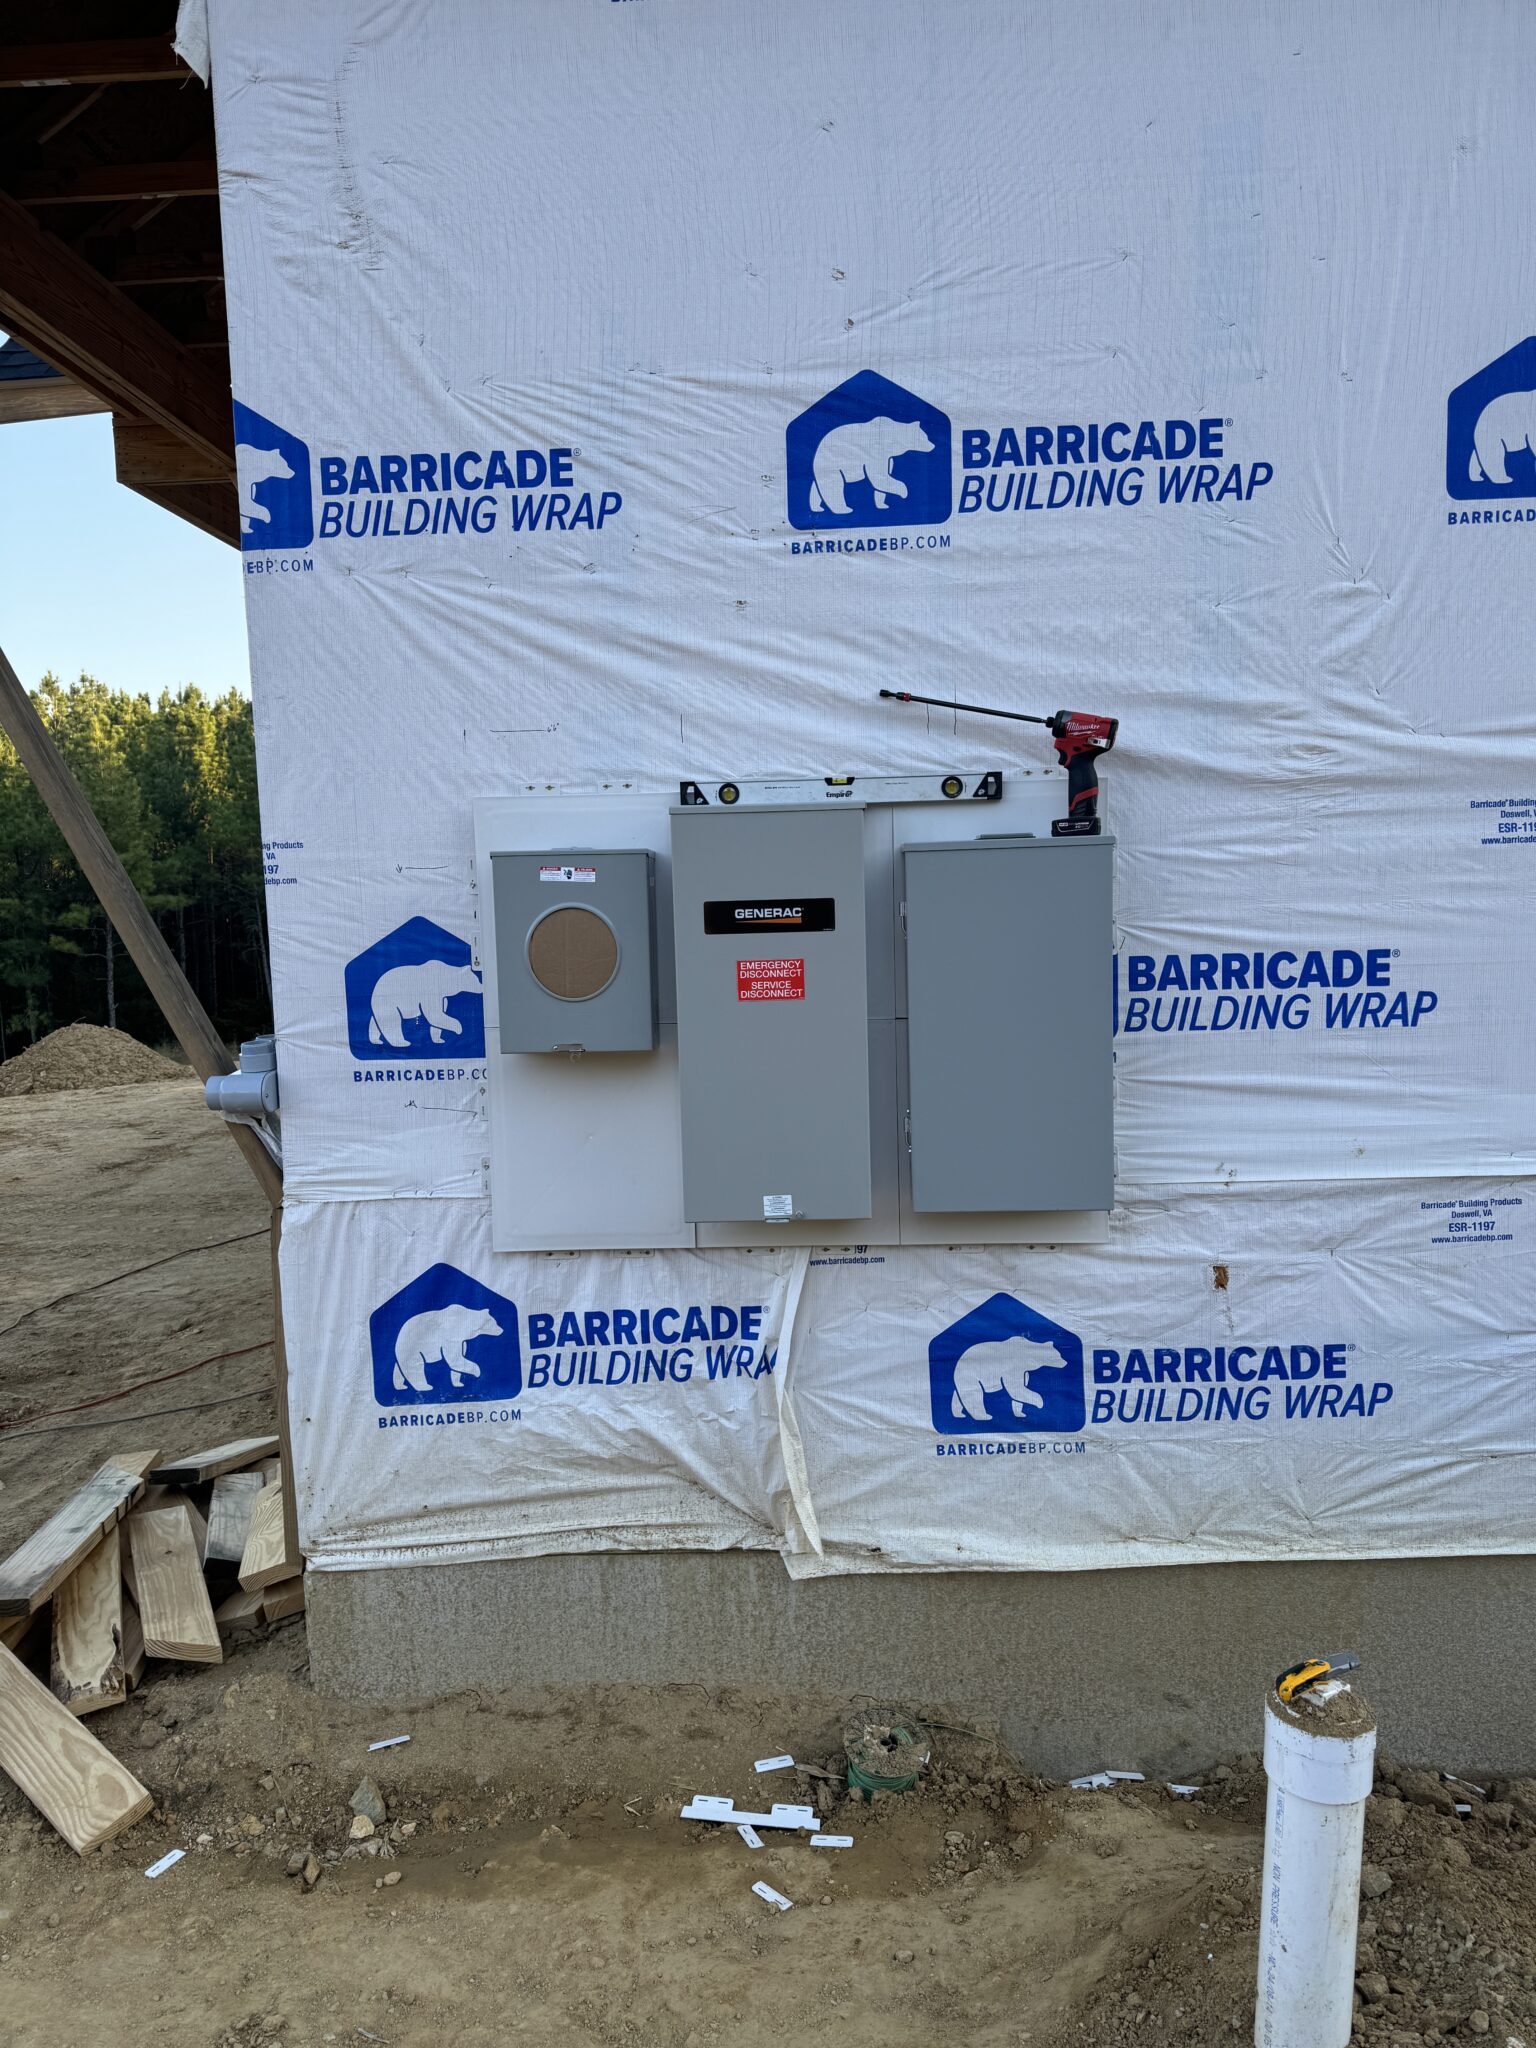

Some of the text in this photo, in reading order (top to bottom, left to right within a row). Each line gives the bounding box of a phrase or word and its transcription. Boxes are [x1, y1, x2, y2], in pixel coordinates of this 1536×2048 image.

[957, 461, 1275, 514] BUILDING WRAP
[318, 490, 624, 539] BUILDING WRAP
[791, 535, 951, 555] BARRICADEBP.COM
[243, 559, 314, 574] EBP.COM
[272, 841, 304, 849] Products
[734, 907, 802, 919] GENERAC
[740, 961, 801, 970] EMERGENCY
[740, 968, 802, 978] DISCONNECT
[751, 980, 792, 989] SERVICE
[740, 988, 803, 998] DISCONNECT
[1123, 990, 1439, 1033] BUILDING WRAP
[1458, 1199, 1489, 1209] Building
[1490, 1197, 1523, 1206] Products
[1451, 1209, 1493, 1219] Doswell, VA
[1448, 1221, 1496, 1233] ESR-1197
[1431, 1233, 1513, 1244] www.barricadebp.com
[809, 1256, 885, 1267] www.barricadebp.com
[527, 1348, 694, 1389] BUILDING
[1091, 1382, 1394, 1424] BUILDING WRAP
[378, 1408, 522, 1429] BARRICADEBP.COM
[936, 1441, 1086, 1456] BARRICADEBP.COM
